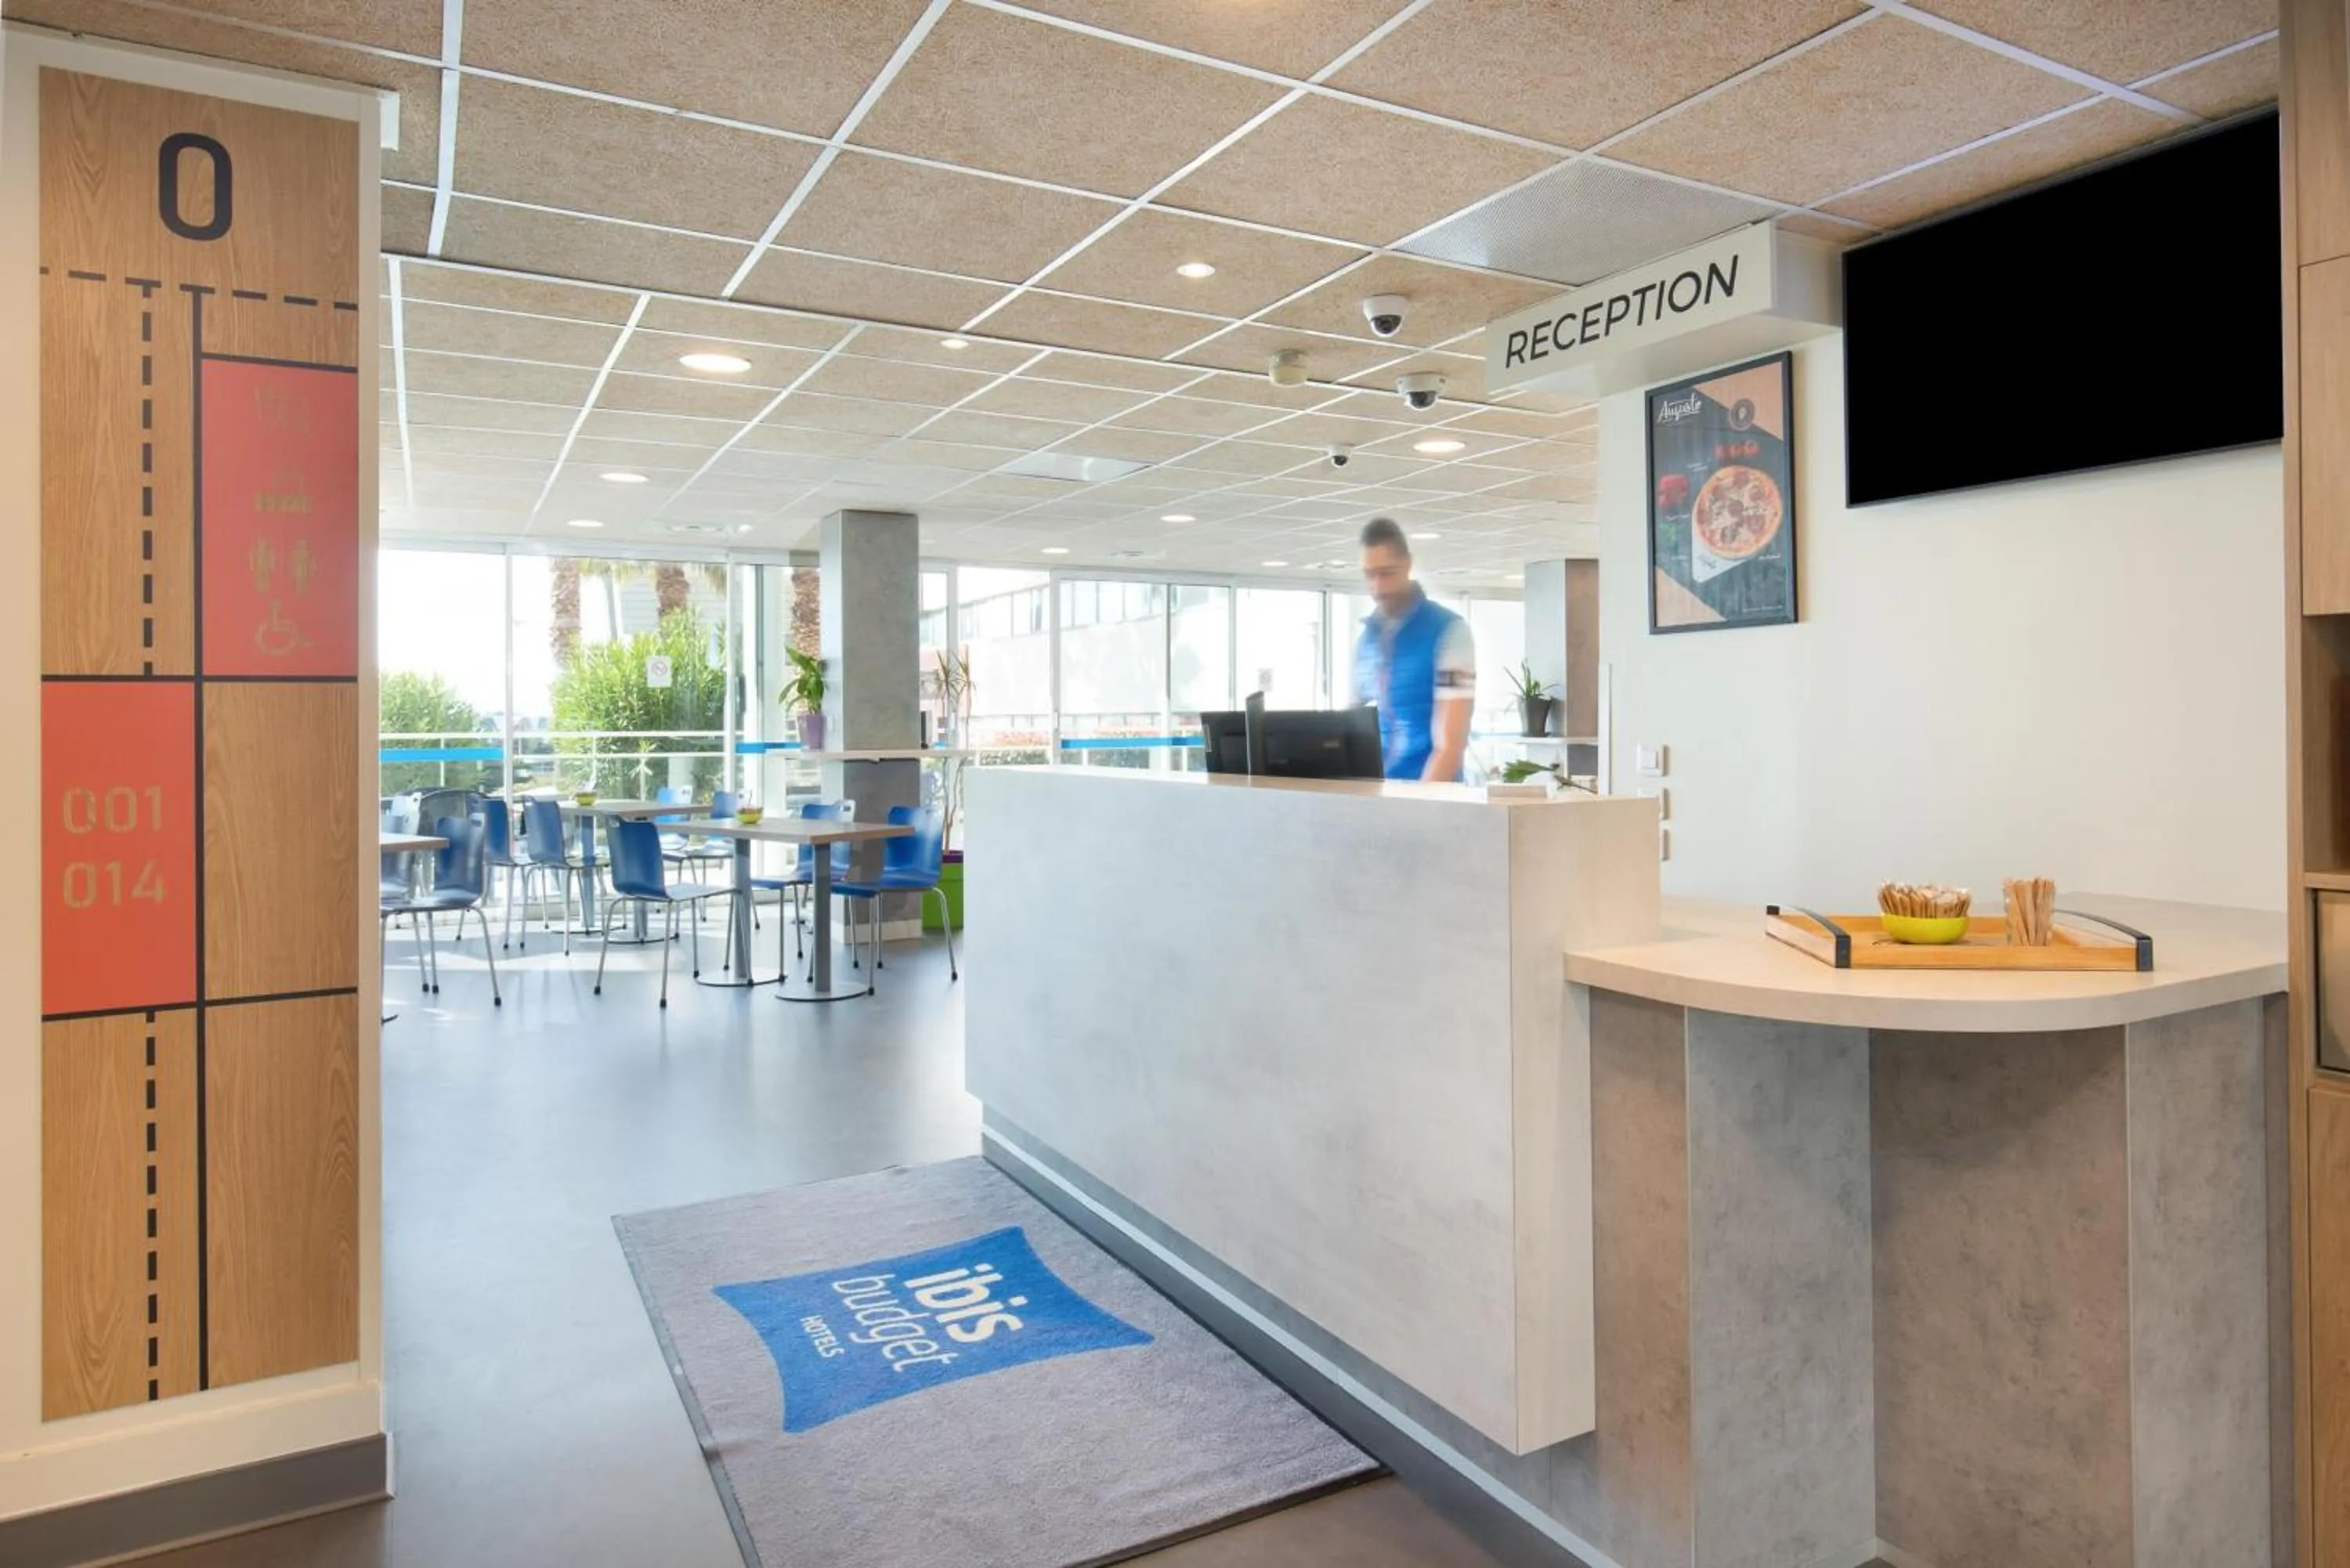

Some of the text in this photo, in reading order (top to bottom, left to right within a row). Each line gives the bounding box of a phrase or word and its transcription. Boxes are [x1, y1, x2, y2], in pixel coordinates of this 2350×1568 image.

[1505, 254, 1739, 369] RECEPTION
[63, 786, 162, 834] 001
[63, 860, 164, 909] 014
[800, 1313, 844, 1357] HOTELS
[831, 1274, 960, 1372] budget
[903, 1263, 1029, 1343] ibis
